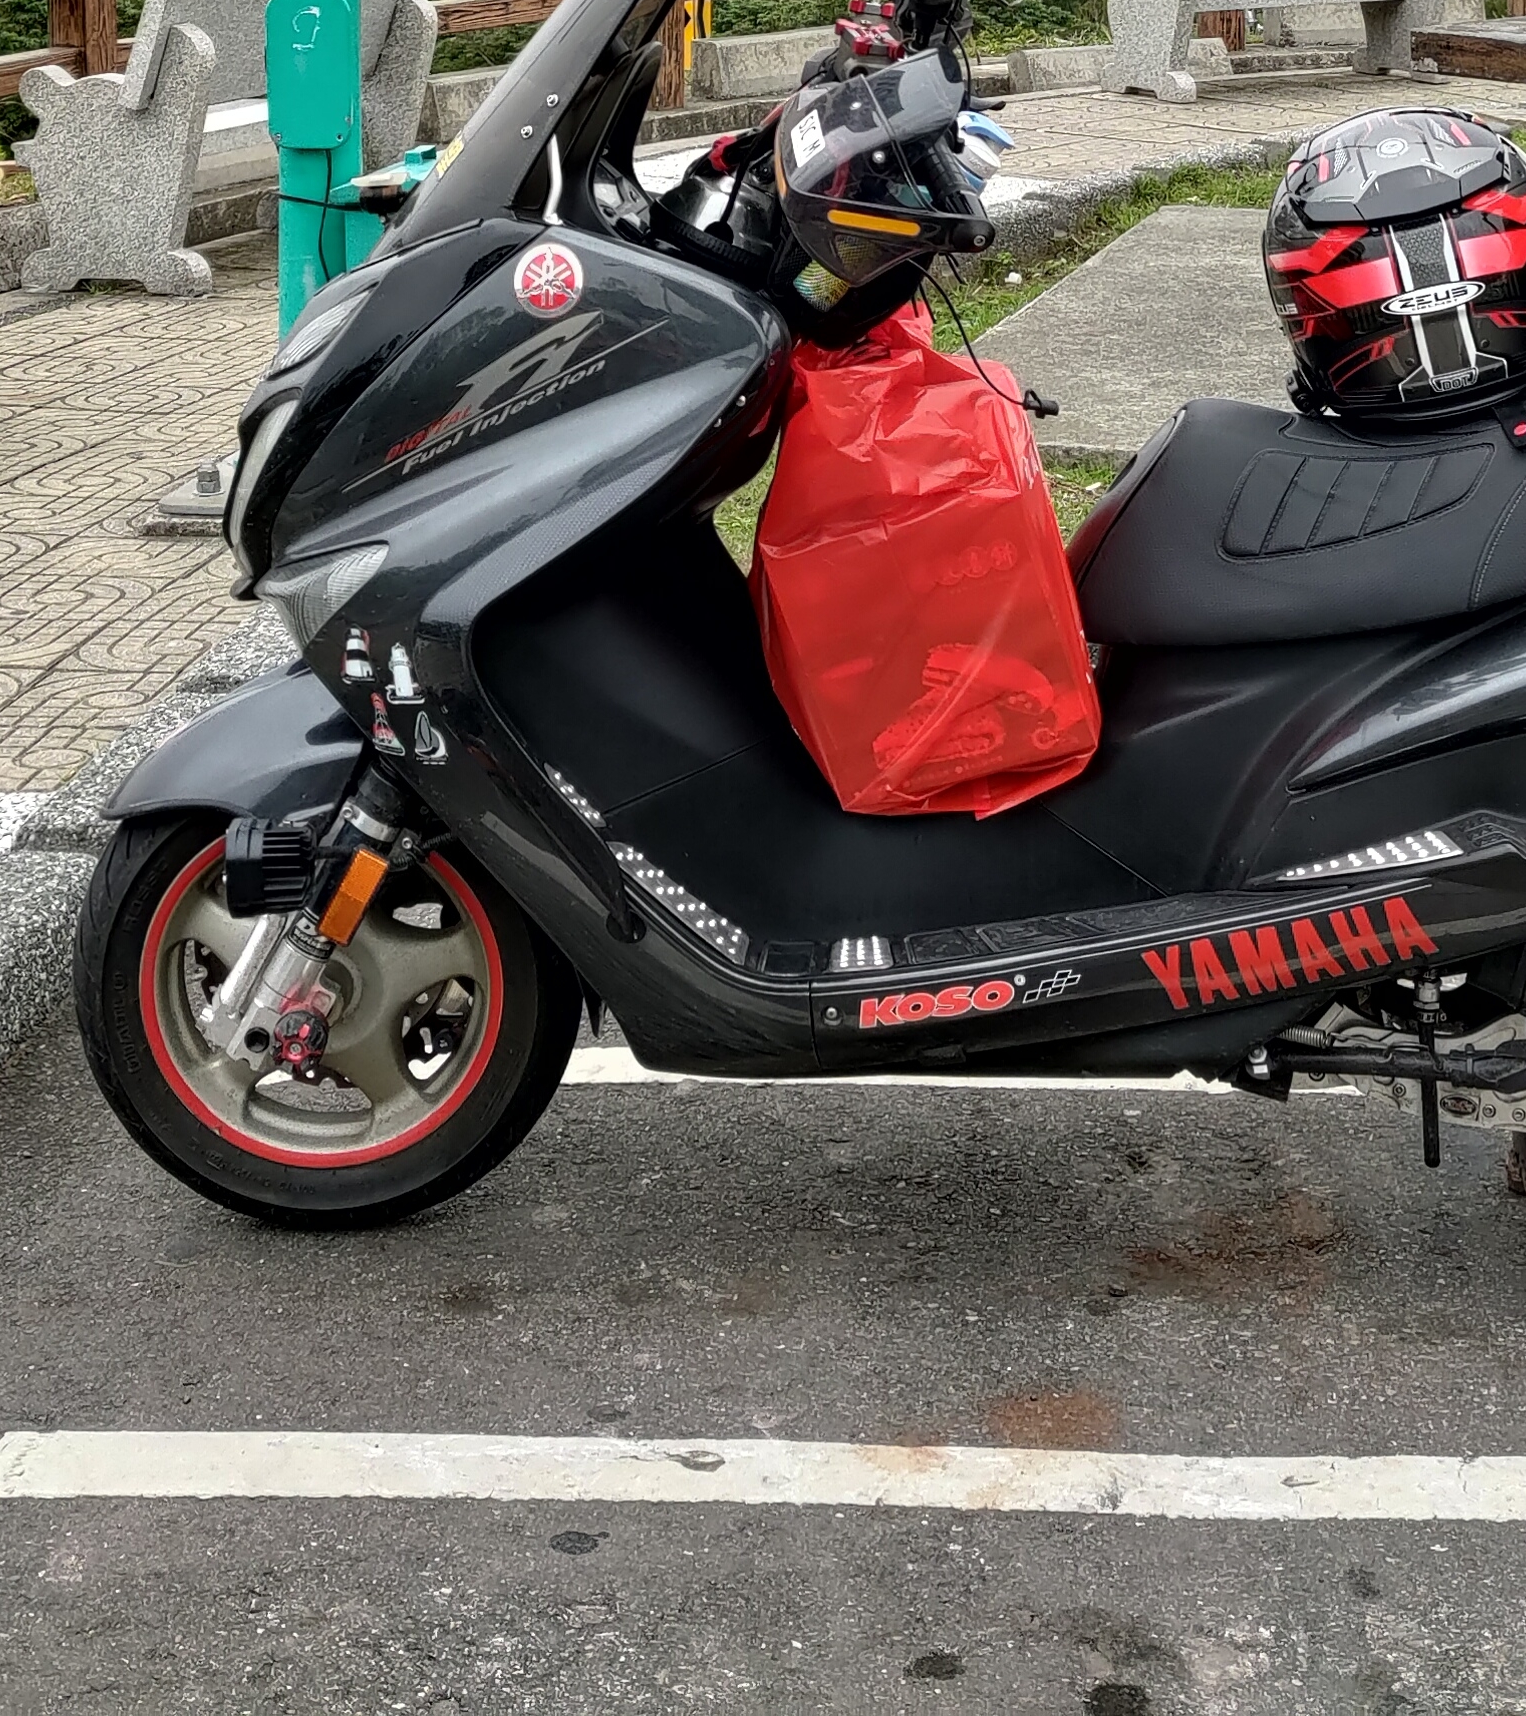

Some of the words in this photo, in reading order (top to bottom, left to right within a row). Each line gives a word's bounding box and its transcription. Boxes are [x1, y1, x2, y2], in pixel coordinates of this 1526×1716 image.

[1398, 285, 1468, 309] ZEUS
[1438, 374, 1472, 391] DOT
[401, 430, 463, 476] Fuel
[469, 359, 606, 437] Injection
[1141, 897, 1440, 1011] YAMAHA
[859, 980, 1015, 1029] KOSO
